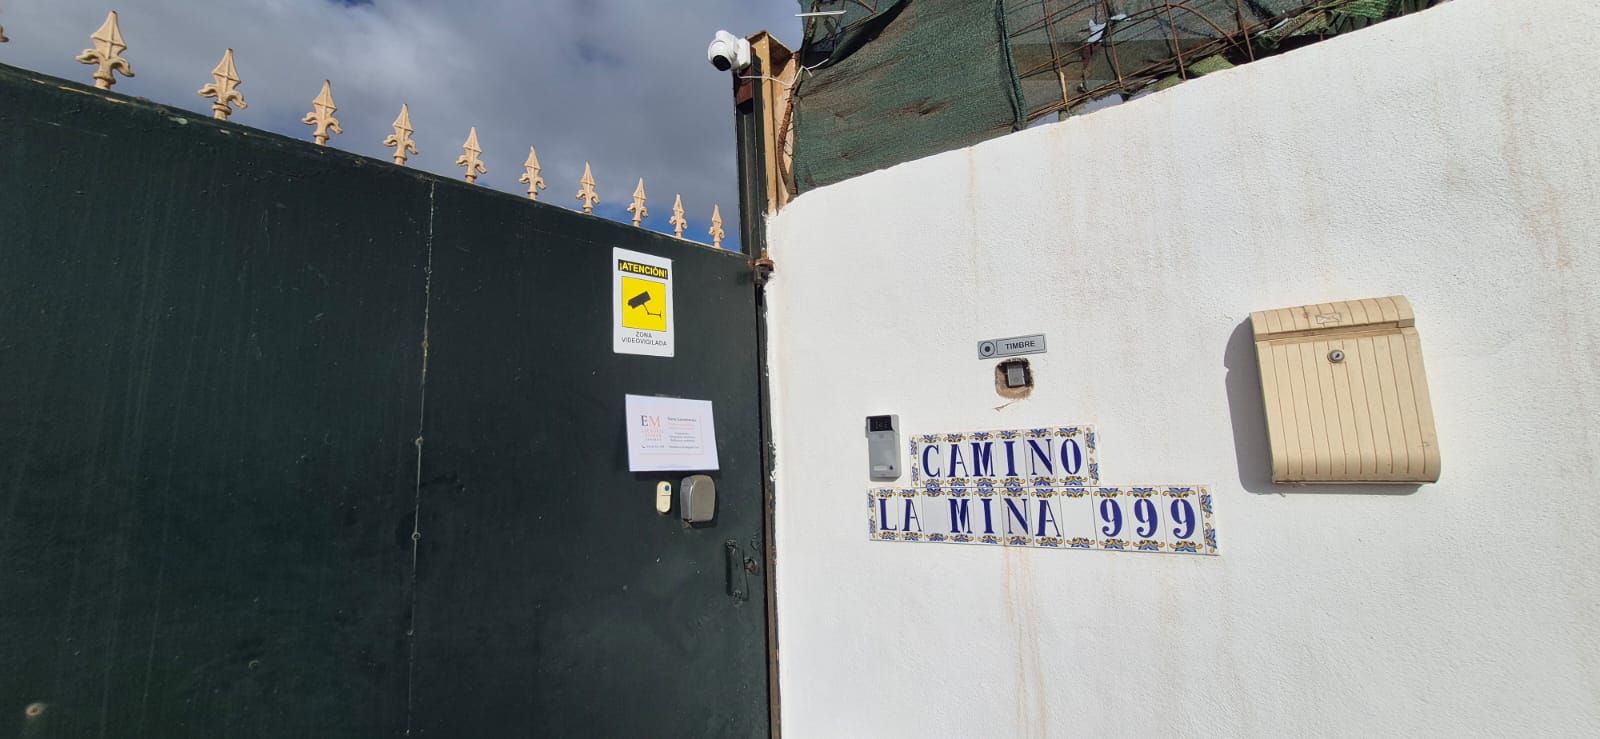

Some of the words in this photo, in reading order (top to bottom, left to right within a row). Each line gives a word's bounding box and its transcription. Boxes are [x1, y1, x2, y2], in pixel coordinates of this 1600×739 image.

[619, 261, 667, 279] ¡ATENCIÓN!
[635, 331, 653, 339] ZONA
[621, 337, 668, 346] VIDEOVIGILADA
[1005, 340, 1036, 350] TIMBRE
[641, 415, 661, 427] EM
[922, 438, 1082, 478] CAMINO
[878, 498, 922, 533] LA
[949, 498, 1062, 538] MINA
[1100, 498, 1196, 540] 999
